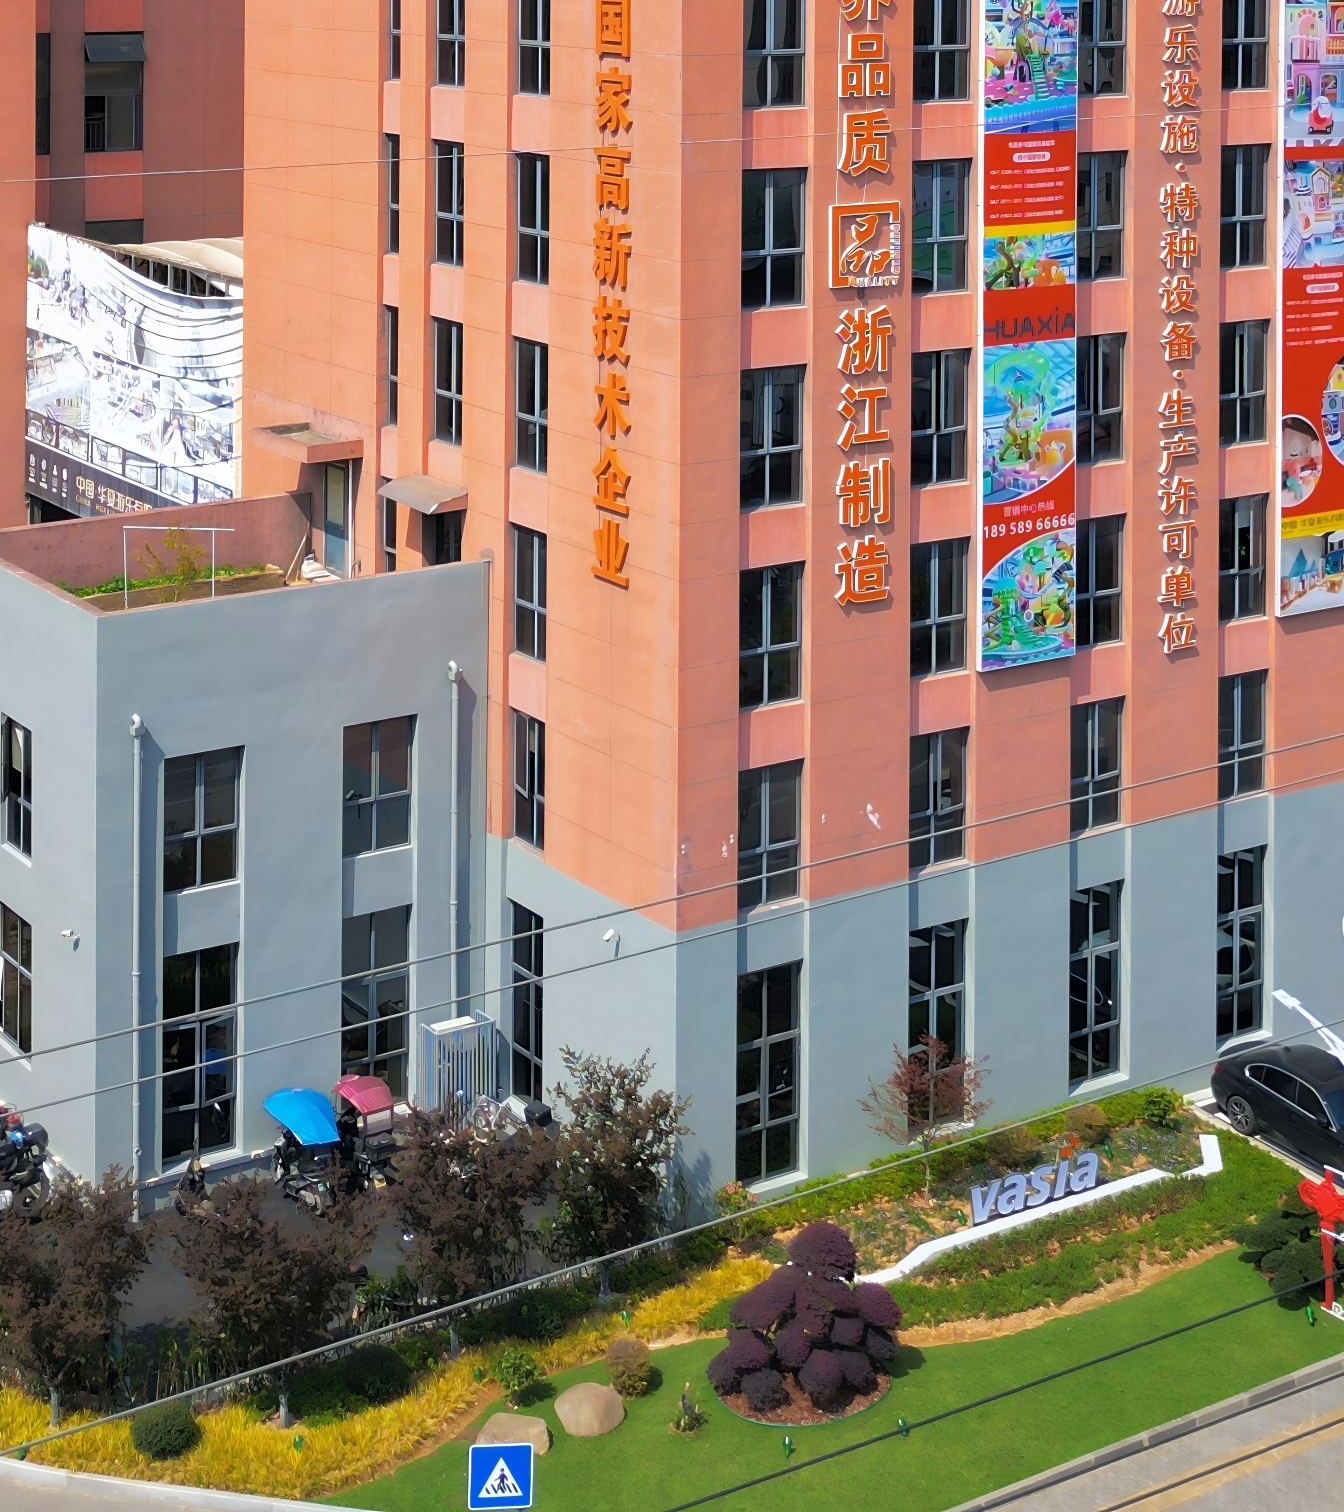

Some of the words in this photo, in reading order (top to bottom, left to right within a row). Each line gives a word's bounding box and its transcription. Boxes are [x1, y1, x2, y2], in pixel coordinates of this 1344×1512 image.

[834, 304, 893, 606] 浙江制造
[983, 522, 1007, 539] 189
[1009, 519, 1033, 536] 589
[1036, 512, 1075, 532] 66666
[970, 1133, 1101, 1226] vasia
